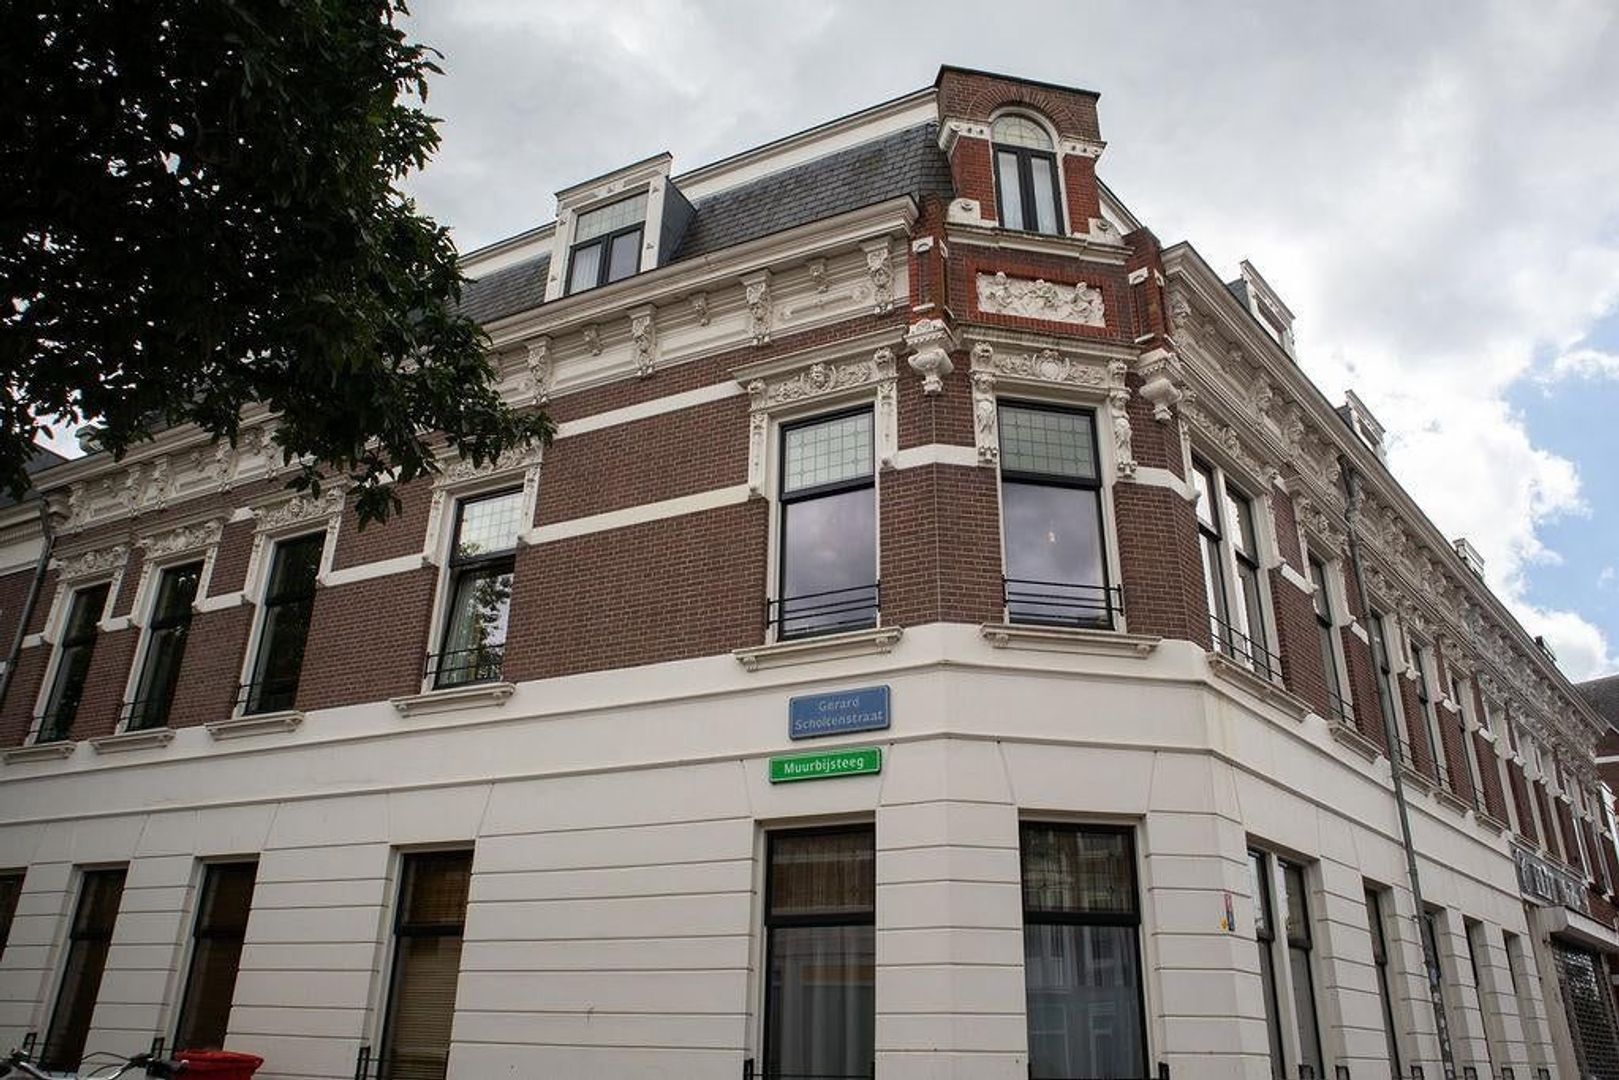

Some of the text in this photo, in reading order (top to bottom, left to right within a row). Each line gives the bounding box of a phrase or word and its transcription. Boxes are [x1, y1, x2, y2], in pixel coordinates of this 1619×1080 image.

[818, 695, 860, 711] Gerard
[795, 711, 884, 730] Scholtenstraat
[784, 757, 865, 774] Muurbijsteeg
